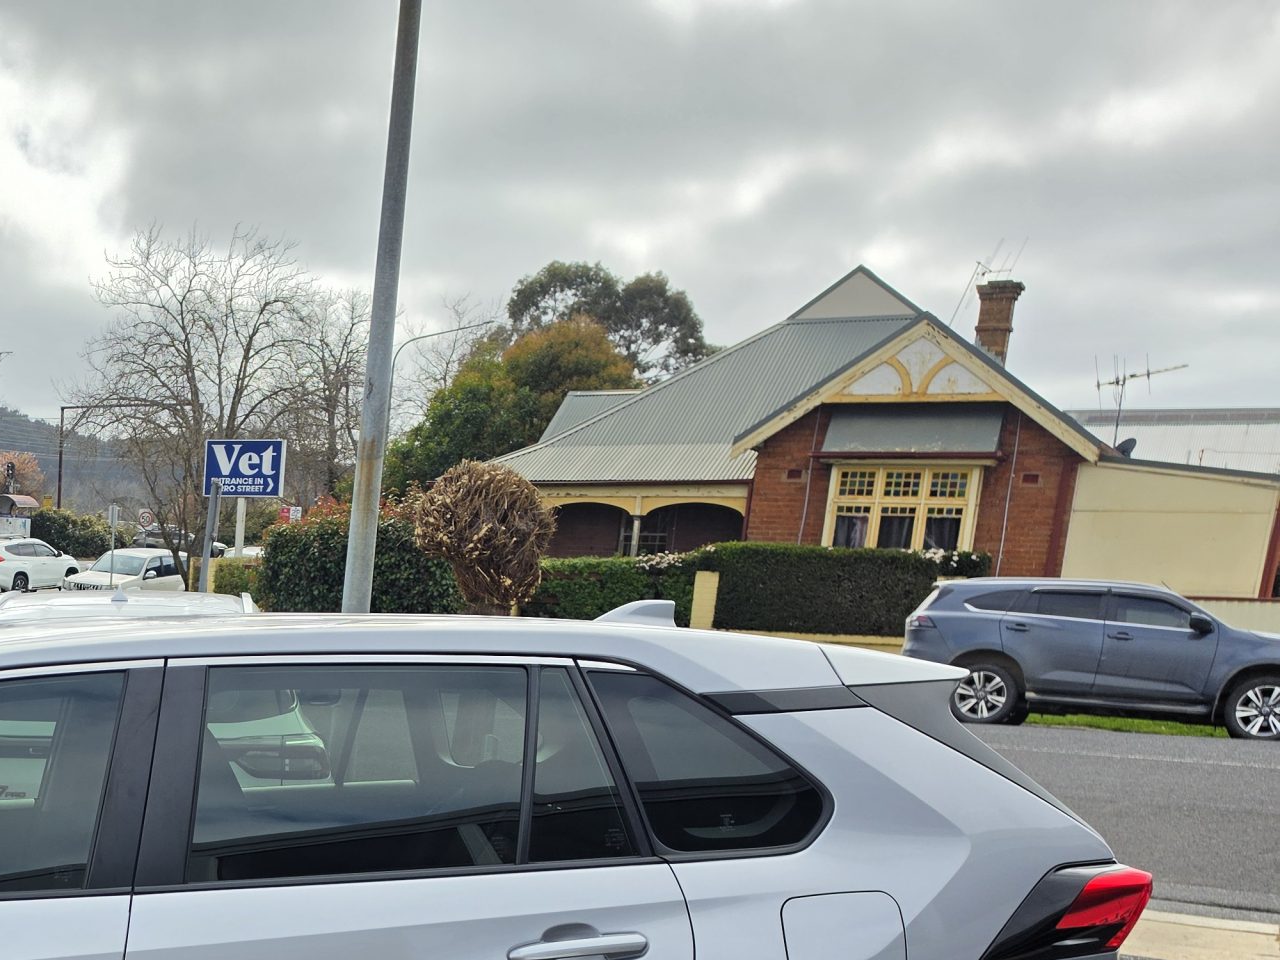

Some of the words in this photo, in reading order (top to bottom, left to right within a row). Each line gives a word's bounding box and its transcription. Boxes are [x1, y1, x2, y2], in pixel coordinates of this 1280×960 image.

[211, 444, 277, 476] Vet
[254, 477, 264, 485] IN
[236, 485, 265, 493] STREET
[141, 515, 152, 524] 50
